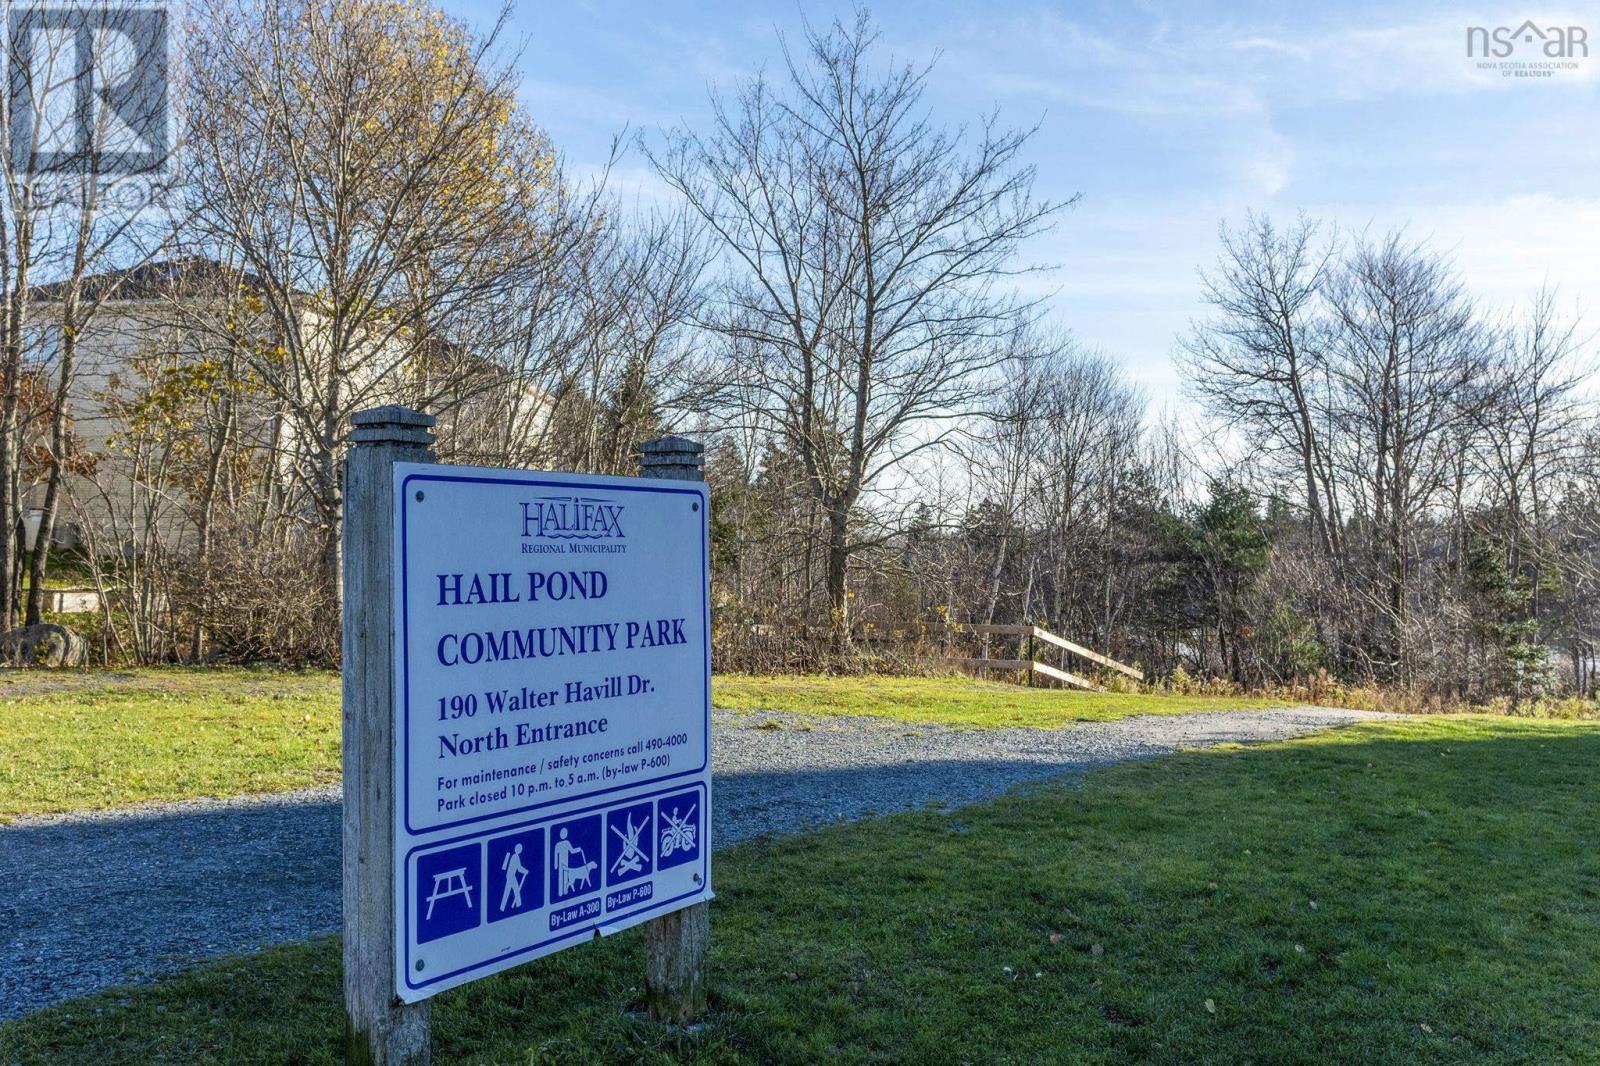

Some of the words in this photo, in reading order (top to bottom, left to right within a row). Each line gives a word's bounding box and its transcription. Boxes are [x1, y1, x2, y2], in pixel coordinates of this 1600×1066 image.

[519, 498, 626, 539] HALIFAX
[521, 542, 567, 554] REGIONAL
[569, 543, 627, 554] MUNICIPALITY
[436, 573, 520, 606] HAIL
[527, 571, 608, 602] POND
[437, 623, 619, 666] COMMUNITY
[625, 618, 687, 649] PARK
[438, 694, 478, 721] 190
[485, 687, 559, 715] Walter
[564, 675, 622, 704] Havill
[627, 674, 656, 696] Dr.
[438, 728, 509, 759] North
[515, 718, 608, 747] Entrance
[437, 776, 458, 791] For
[462, 763, 537, 787] maintenance
[539, 757, 545, 775] /
[547, 754, 580, 770] safety
[582, 747, 625, 764] concerns
[627, 740, 643, 755] call
[645, 733, 688, 752] 490-4000
[437, 794, 466, 813] Park
[469, 785, 508, 806] closed
[511, 783, 525, 798] 10
[528, 781, 552, 798] p.m.
[555, 777, 565, 789] to
[568, 773, 575, 786] 5
[577, 772, 600, 784] a.m.
[602, 762, 639, 781] (by-law
[641, 753, 671, 770] P-600)
[551, 908, 578, 926] By-Law
[579, 901, 600, 917] A-300
[607, 891, 632, 909] By-Law
[632, 884, 652, 900] P-600
